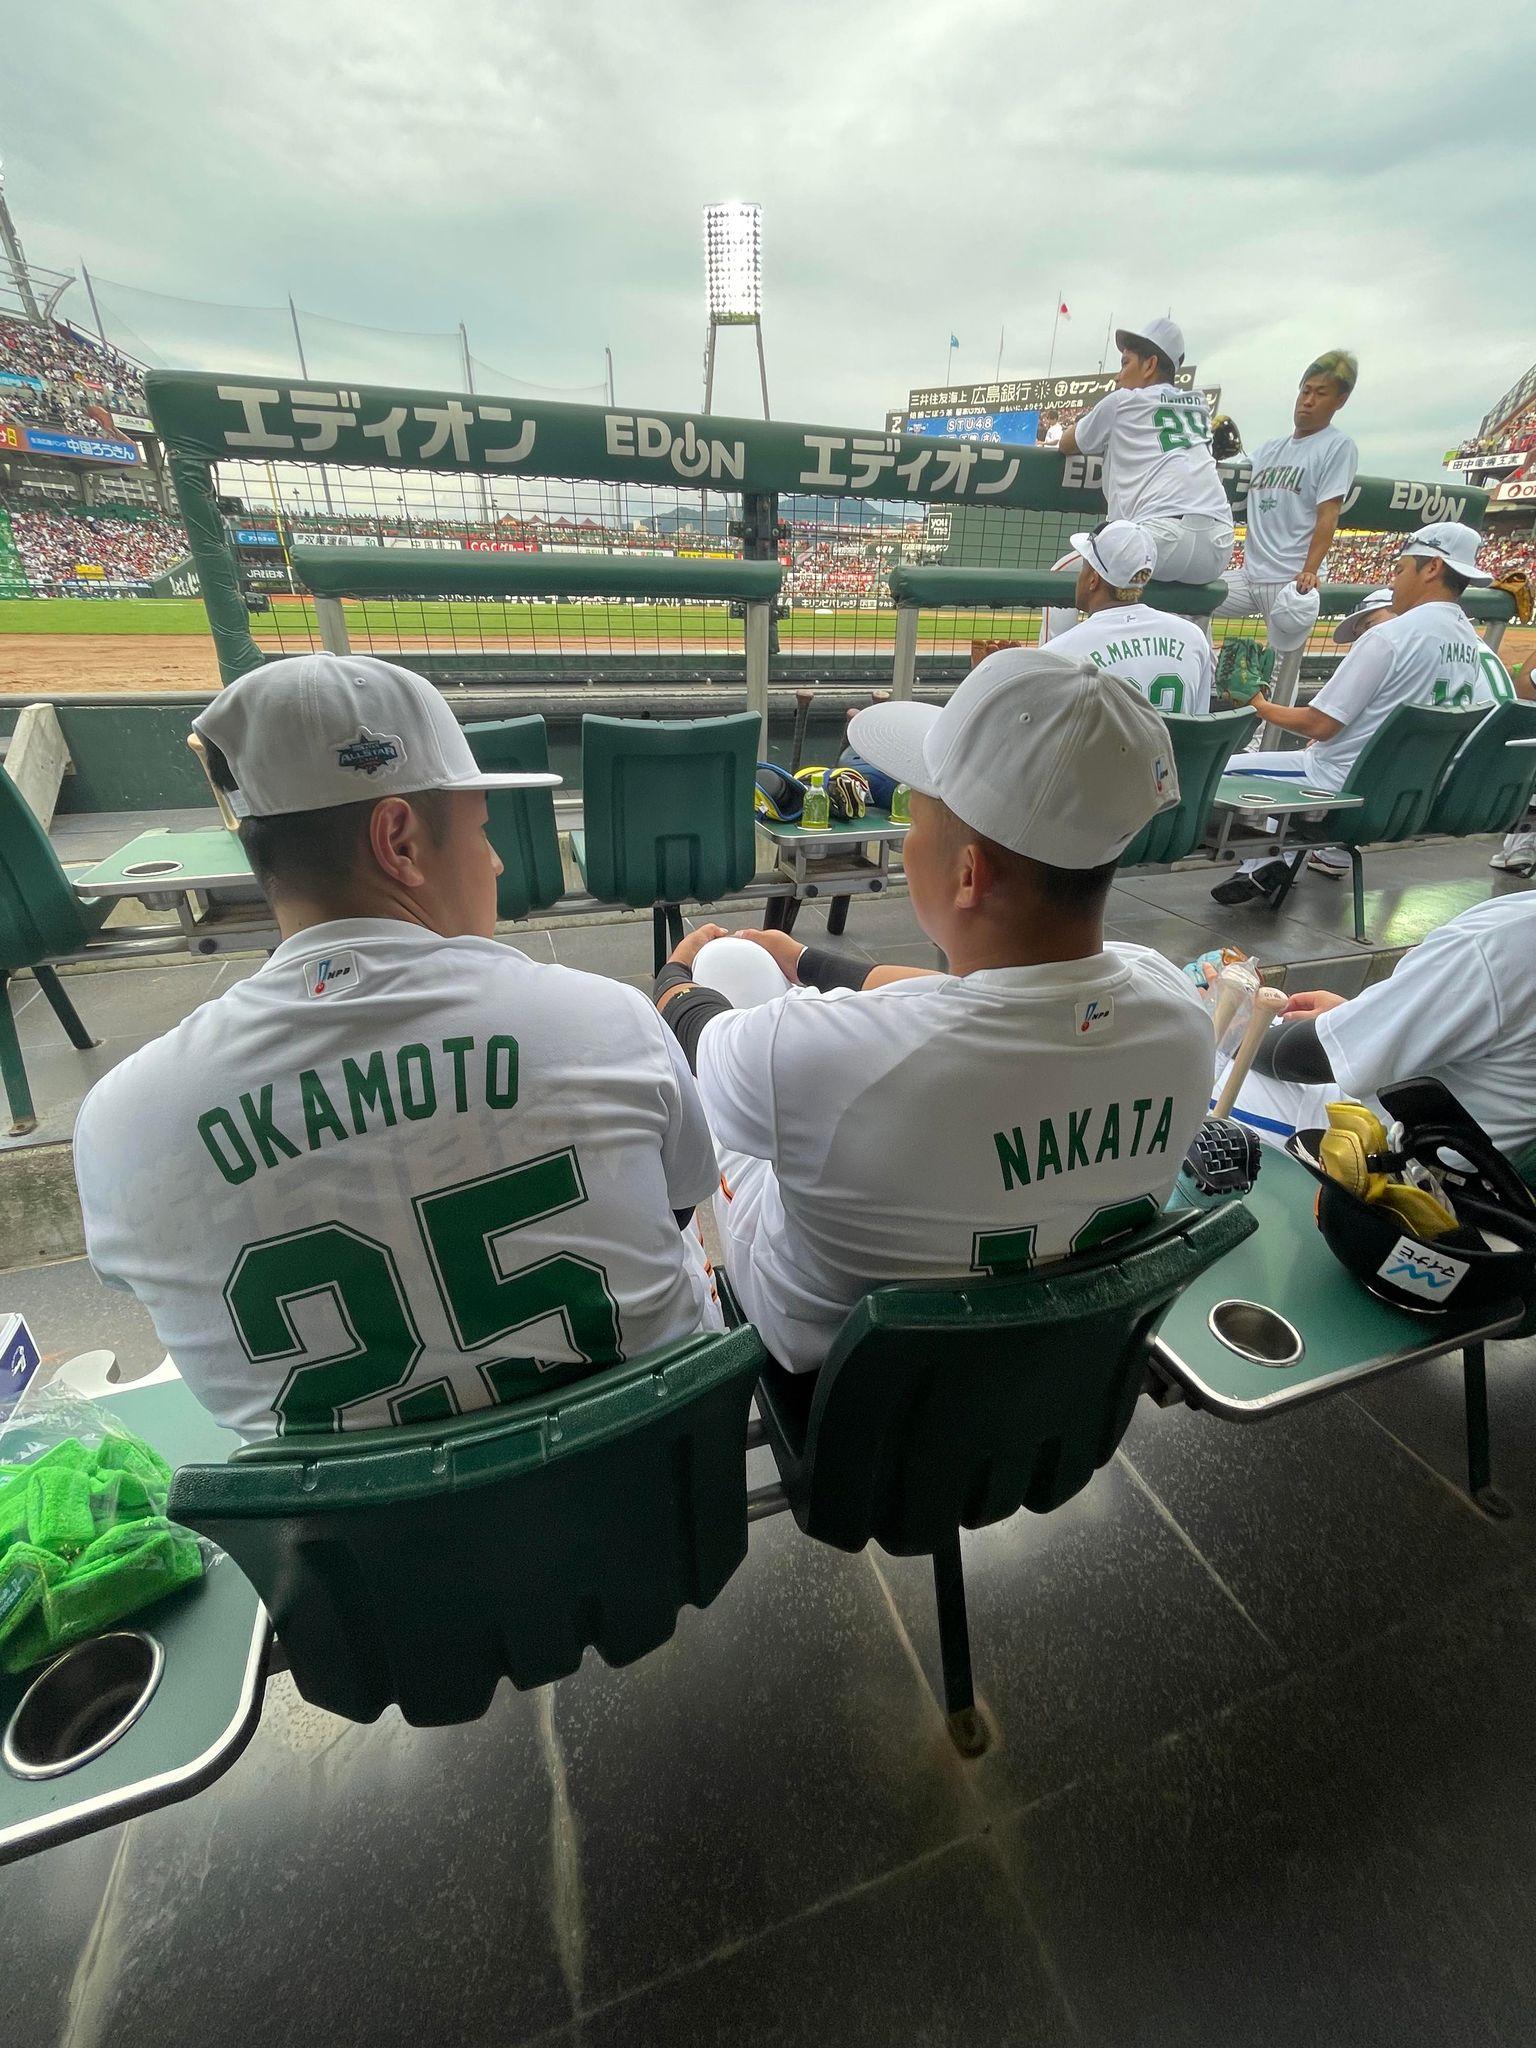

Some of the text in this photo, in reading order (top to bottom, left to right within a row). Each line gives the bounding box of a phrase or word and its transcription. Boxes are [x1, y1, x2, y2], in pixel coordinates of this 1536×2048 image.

[910, 391, 968, 406] 三井住友海上
[971, 382, 1032, 405] 広島銀行
[216, 385, 537, 463] エディオン
[947, 416, 994, 432] STU48
[604, 414, 745, 480] EDION
[799, 434, 1021, 494] エディオン
[1251, 464, 1306, 496] CENTRAL
[930, 518, 949, 529] you
[1089, 637, 1186, 669] R.MARTINEZ
[197, 1034, 519, 1186] OKAMOTO
[993, 1096, 1174, 1192] NAKATA
[1400, 1245, 1456, 1279] マイナビ
[222, 1144, 627, 1440] 25
